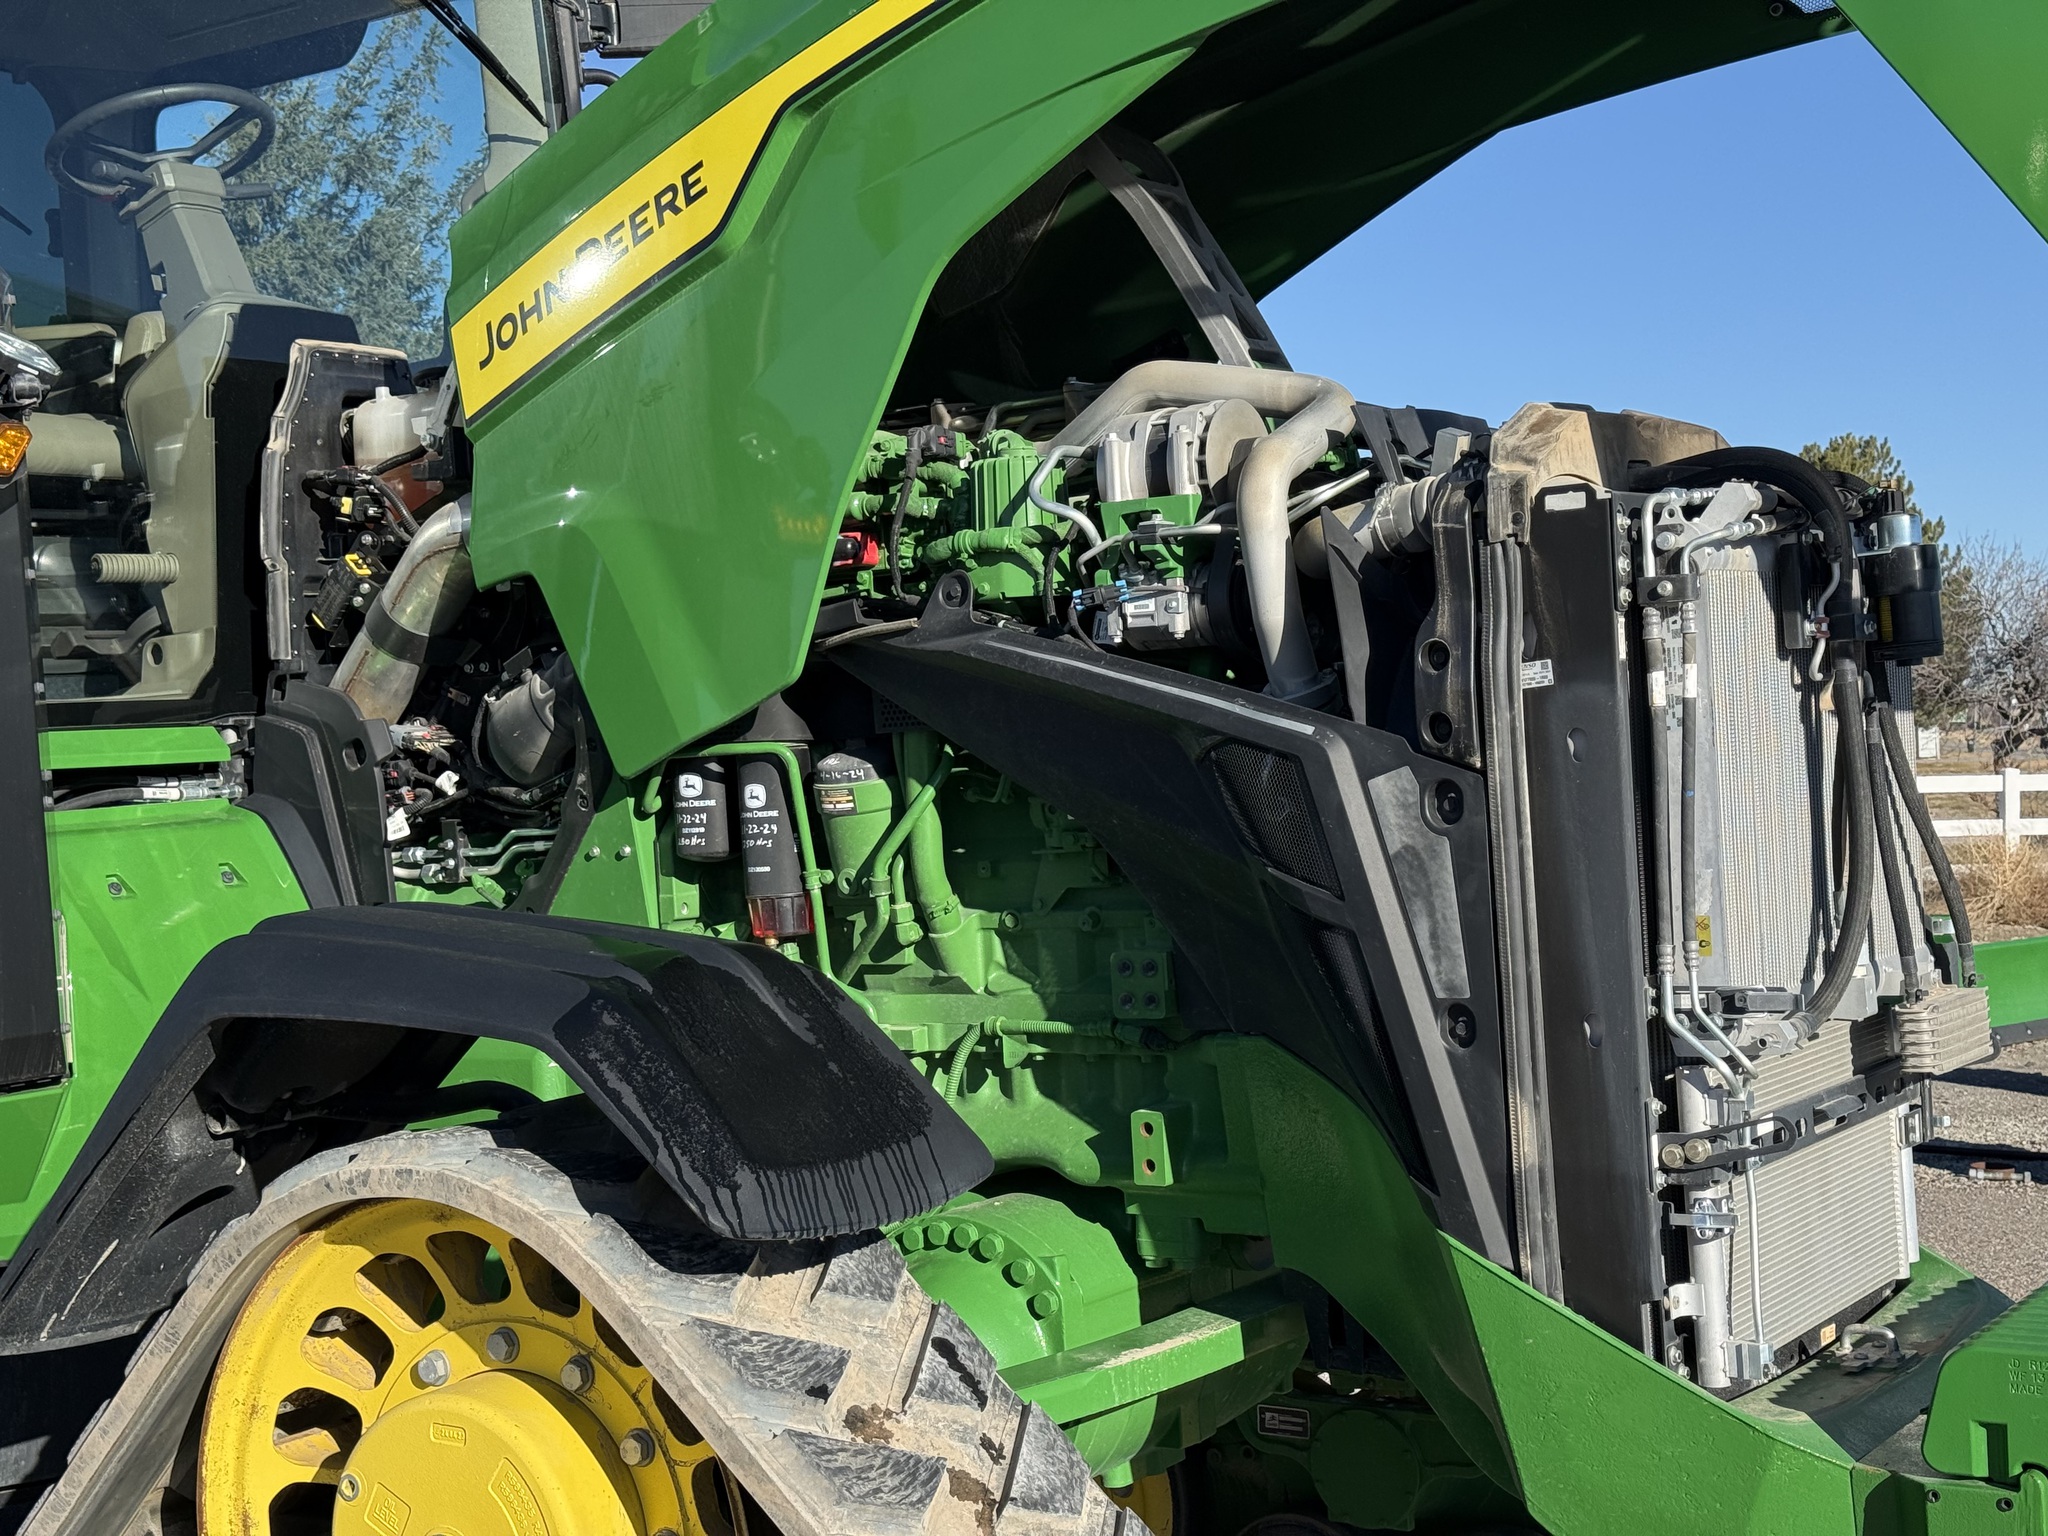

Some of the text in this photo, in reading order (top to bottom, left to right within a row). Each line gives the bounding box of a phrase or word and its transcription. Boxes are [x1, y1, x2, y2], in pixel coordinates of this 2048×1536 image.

[478, 159, 709, 371] JOHN DEERE
[820, 768, 865, 781] 4-16-24
[689, 799, 717, 807] DEERE
[753, 810, 779, 818] DEERE
[2008, 1358, 2021, 1369] JD
[2008, 1370, 2027, 1382] WF
[2009, 1383, 2043, 1396] MADE
[383, 1497, 397, 1516] OIL
[373, 1502, 399, 1531] LEVEL
